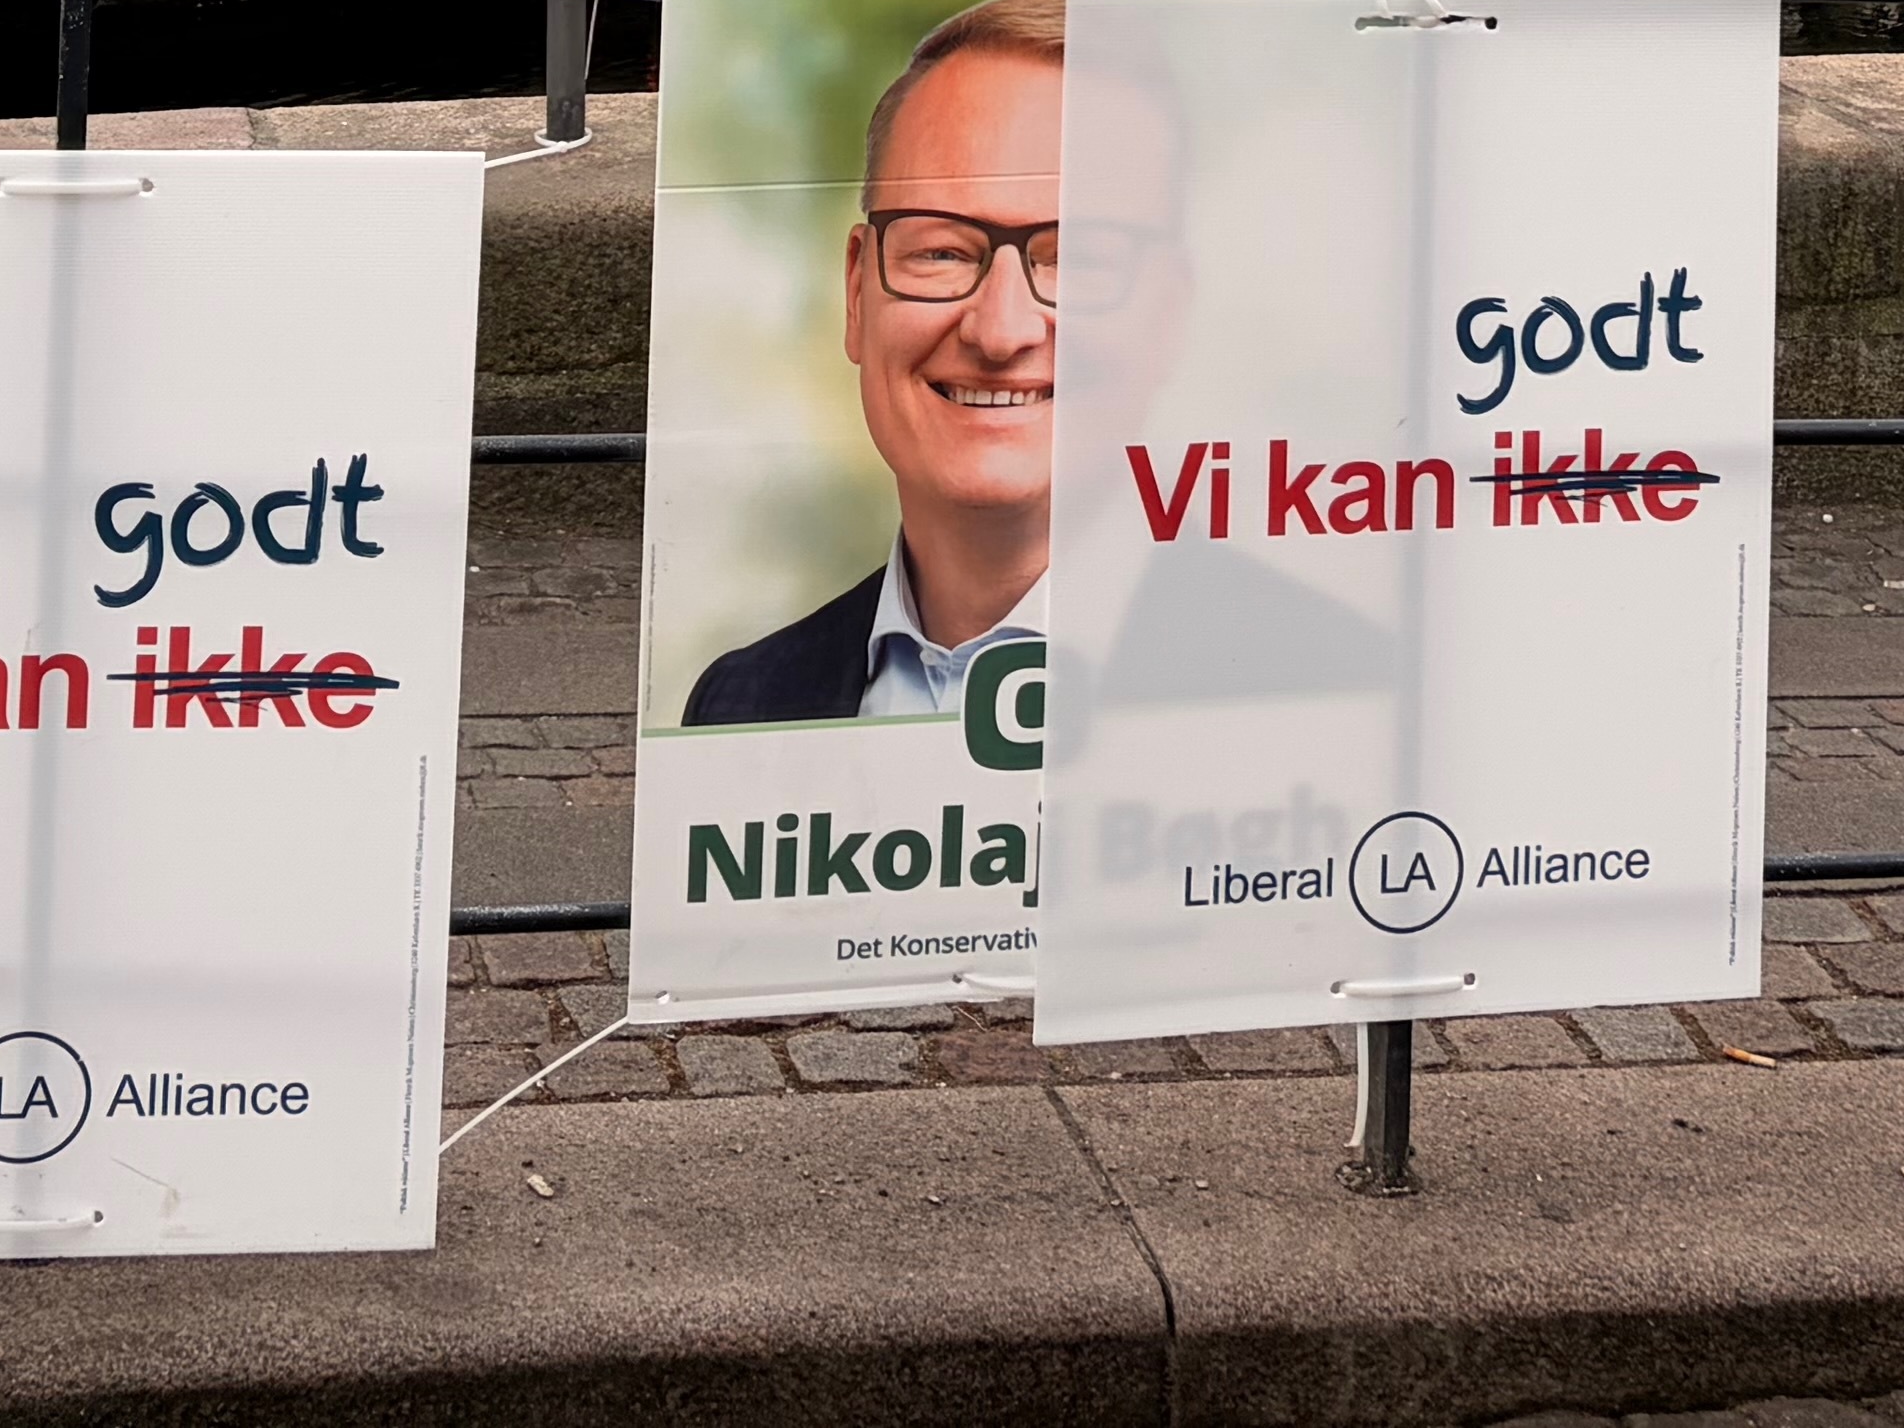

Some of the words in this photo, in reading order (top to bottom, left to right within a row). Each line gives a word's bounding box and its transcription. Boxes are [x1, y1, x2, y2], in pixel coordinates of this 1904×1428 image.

[1456, 267, 1704, 415] godt
[94, 453, 384, 608] godt
[1126, 442, 1231, 542] Vi
[1267, 440, 1455, 537] kan
[1494, 429, 1700, 527] ikke
[133, 626, 376, 729] ikke
[1185, 858, 1333, 906] Liberal
[1381, 852, 1434, 893] LA
[1477, 845, 1649, 888] Alliance
[838, 939, 882, 960] Det
[106, 1073, 309, 1117] Alliance
